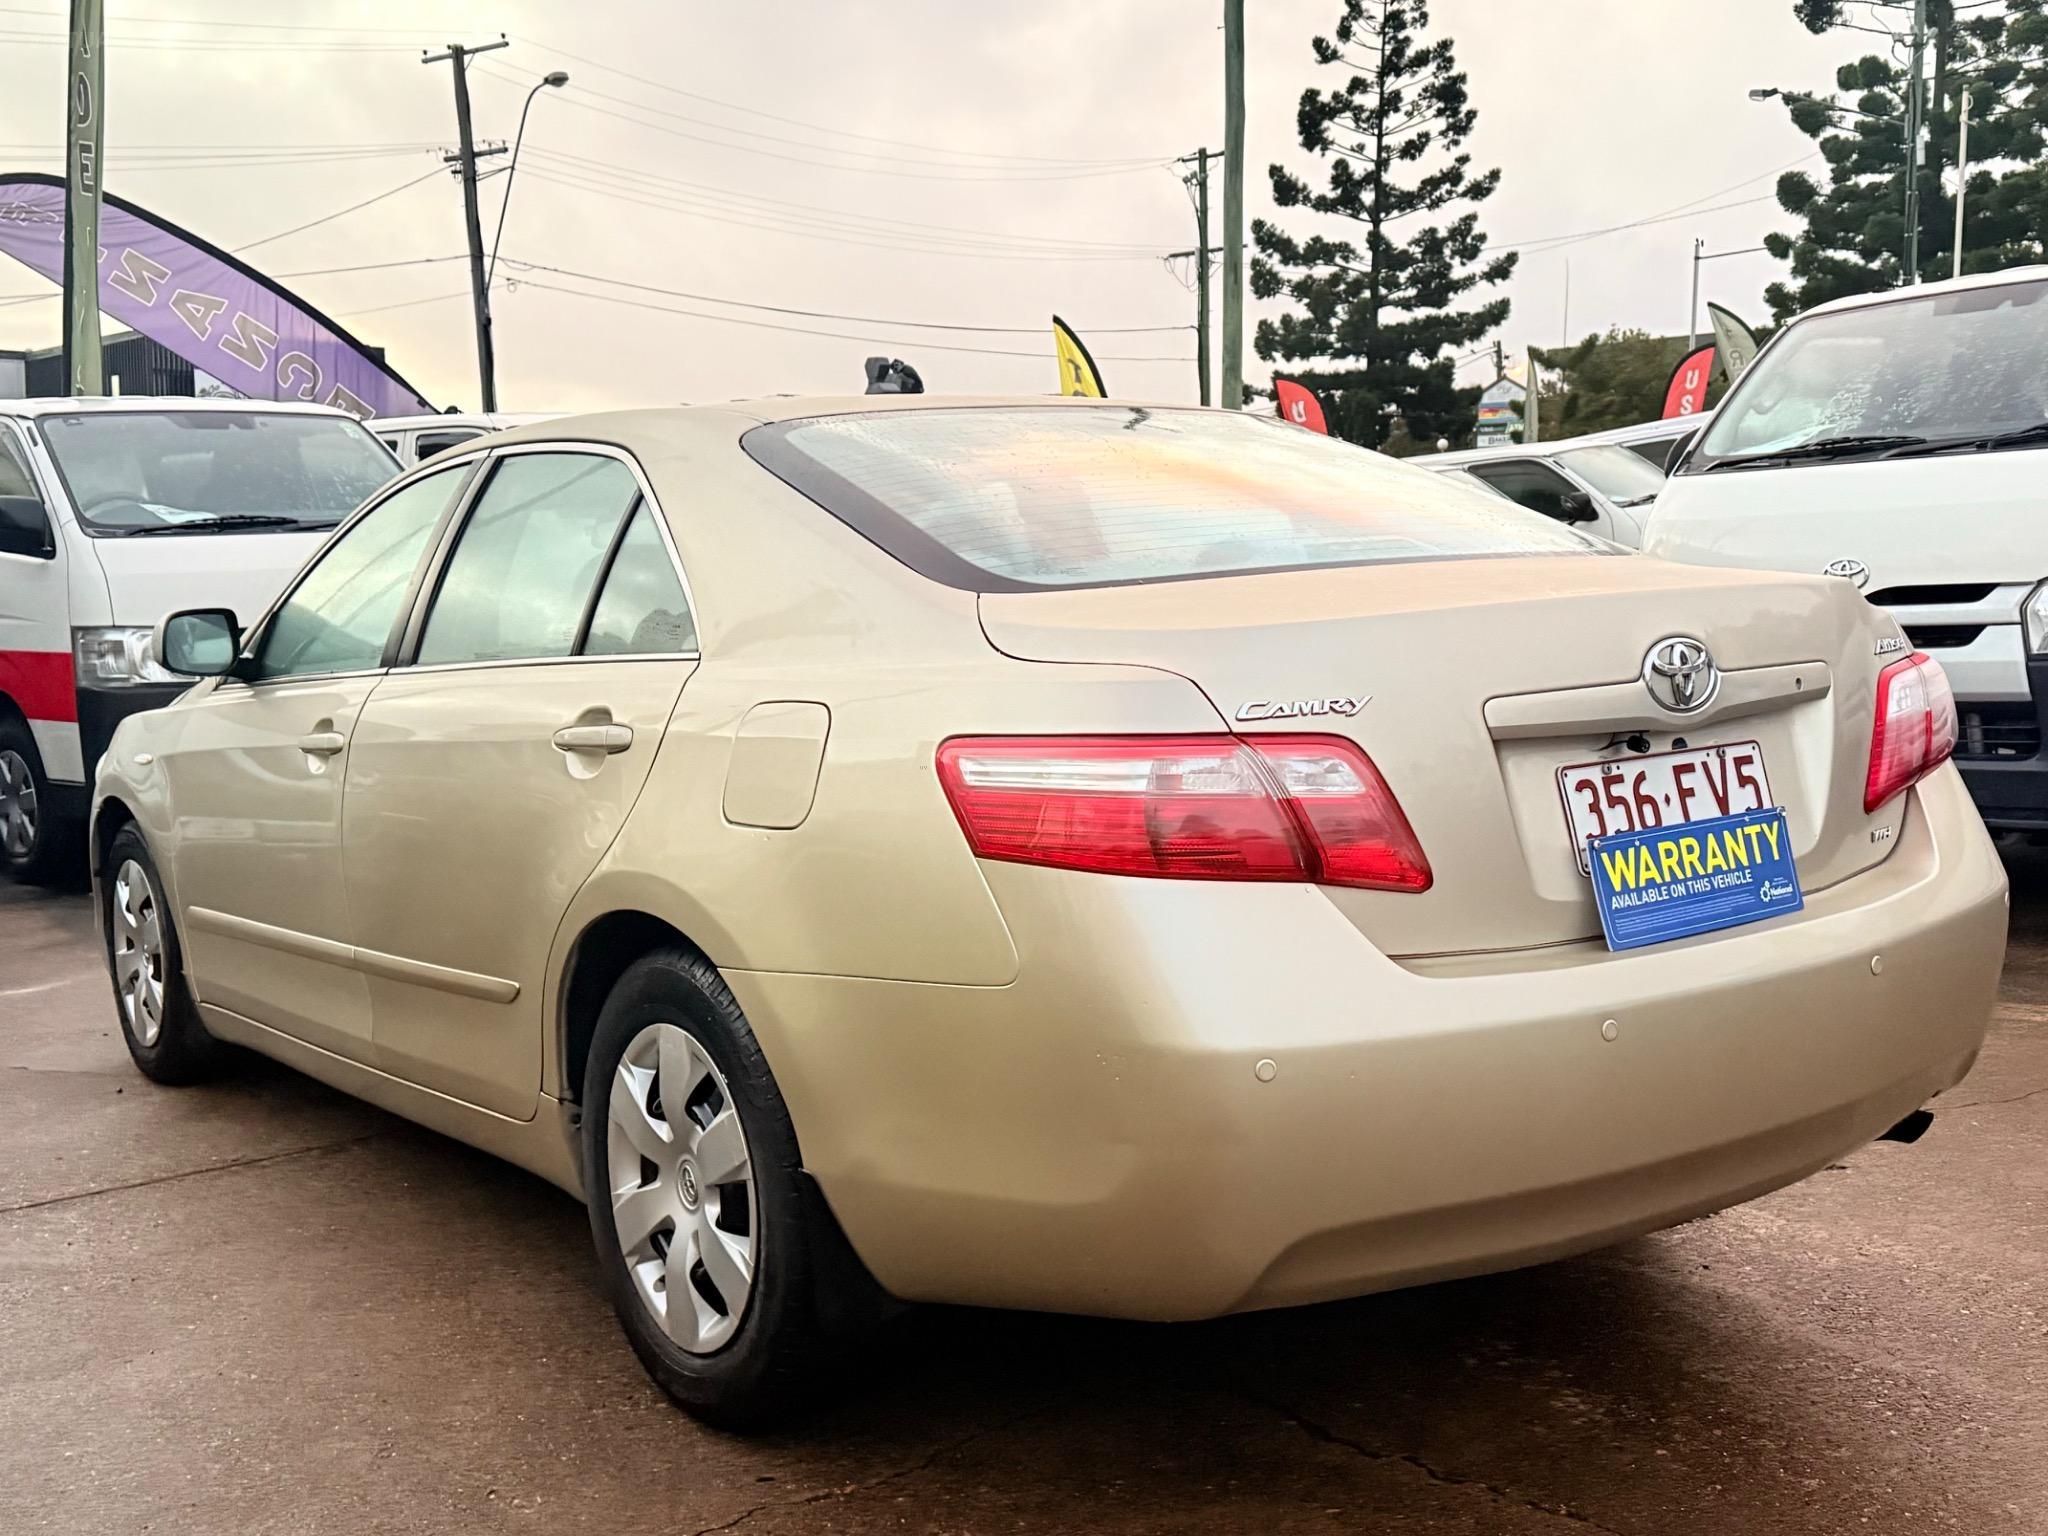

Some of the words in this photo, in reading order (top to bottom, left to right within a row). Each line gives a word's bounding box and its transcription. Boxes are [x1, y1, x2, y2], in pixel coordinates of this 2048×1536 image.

[1235, 695, 1373, 722] CAMRY
[1601, 821, 1781, 892] WARRANTY
[1612, 886, 1670, 910] AVAILABLE
[1670, 883, 1686, 897] ON
[1687, 877, 1711, 894] THIS
[1710, 869, 1753, 889] VEHICLE
